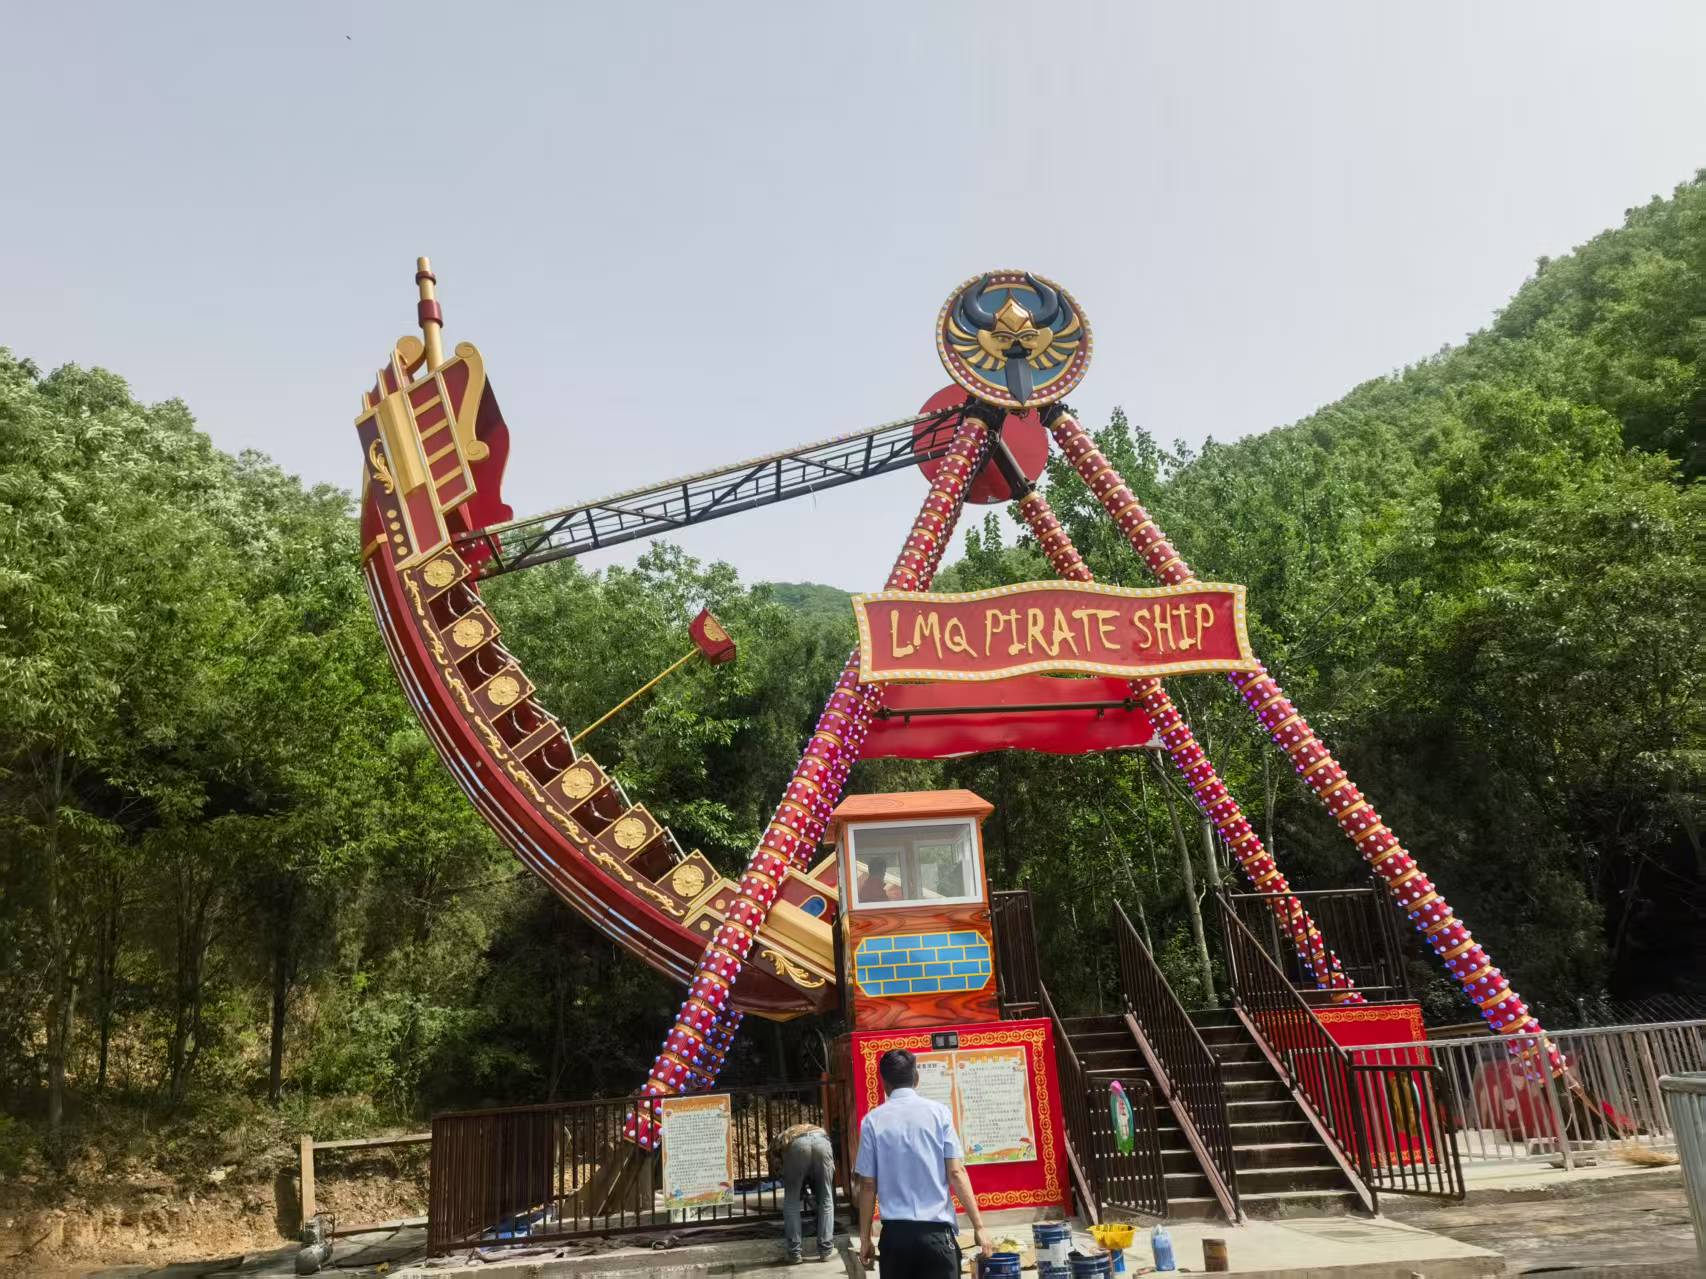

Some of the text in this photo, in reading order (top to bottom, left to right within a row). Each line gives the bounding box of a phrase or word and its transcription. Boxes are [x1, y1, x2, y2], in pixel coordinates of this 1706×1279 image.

[890, 603, 1214, 658] LMQ PIRATE SHIP
